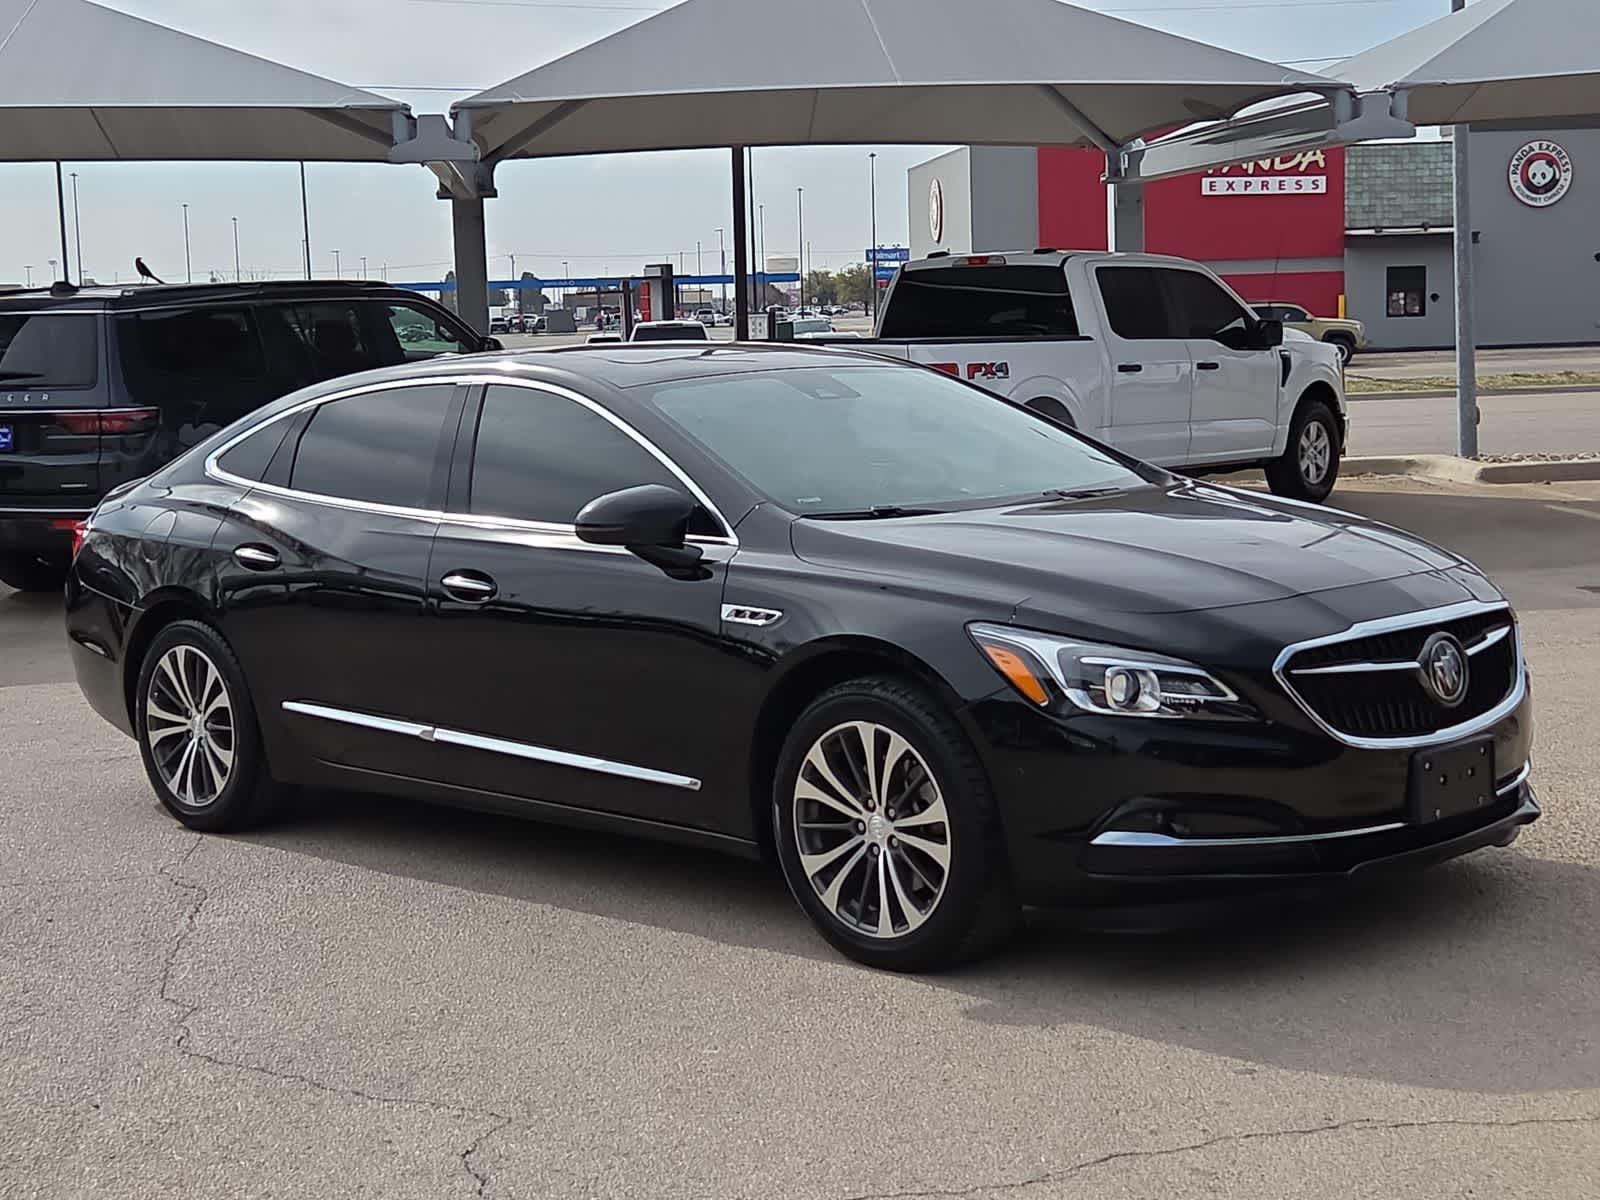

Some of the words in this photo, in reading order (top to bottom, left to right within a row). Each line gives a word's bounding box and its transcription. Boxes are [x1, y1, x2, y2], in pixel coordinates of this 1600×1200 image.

[1511, 145, 1535, 175] PANDA
[1538, 143, 1570, 173] EXPRESS
[1209, 179, 1320, 192] EXPRESS
[967, 360, 1010, 380] FX4
